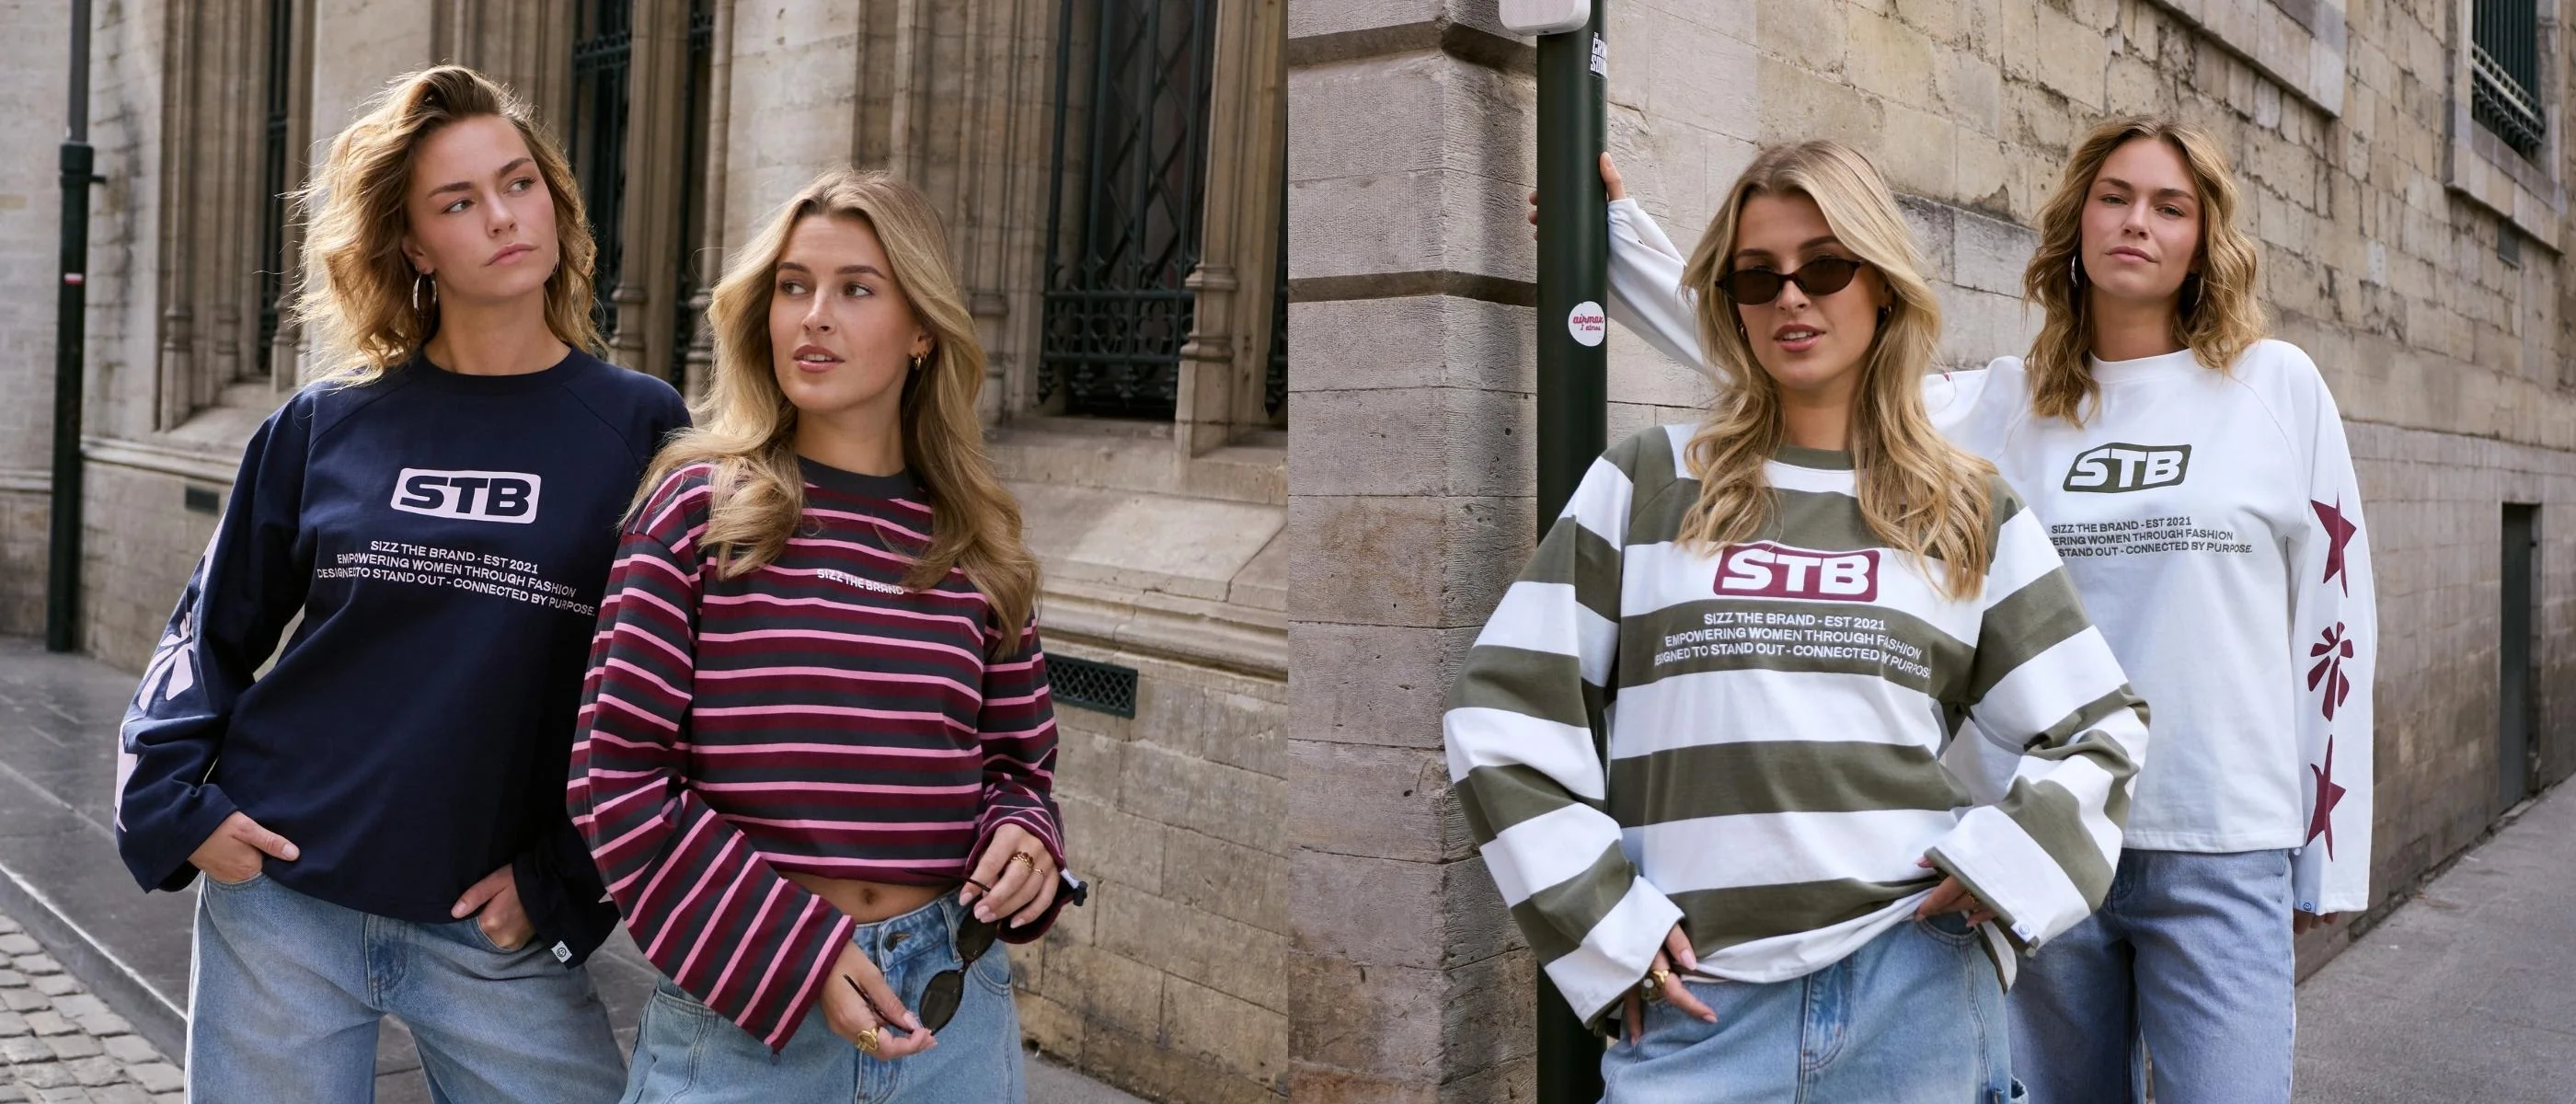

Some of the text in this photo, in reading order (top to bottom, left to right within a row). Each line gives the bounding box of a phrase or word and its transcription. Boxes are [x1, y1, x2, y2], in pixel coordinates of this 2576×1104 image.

[2070, 448, 2183, 489] STB
[400, 475, 532, 517] STB
[2050, 529, 2233, 546] ERING WOMEN THROUGH FASHION
[2052, 524, 2075, 534] SIZZ
[2076, 523, 2098, 533] THE
[2099, 521, 2139, 533] BRAND
[2145, 518, 2165, 528] EST
[2167, 516, 2191, 526] 2021
[371, 541, 398, 553] SIZZ
[401, 544, 426, 557] THE
[430, 547, 475, 561] BRAND
[483, 554, 509, 568] EST
[509, 559, 538, 574] 2021
[2057, 547, 2093, 558] STAND
[2095, 546, 2119, 557] OUT
[2126, 542, 2189, 554] CONNECTED
[2191, 542, 2205, 551] BY
[337, 553, 577, 598] EMPOWERING WOMEN THROUGH FASHION
[817, 568, 904, 595] SIZZ THE BRAND
[1722, 548, 1870, 595] STB
[356, 567, 371, 578] TO
[373, 569, 415, 582] STAND
[418, 574, 445, 586] OUT
[454, 578, 529, 602] CONNECTED
[531, 593, 548, 605] BY
[549, 597, 595, 617] PURPOSE.
[1704, 613, 1734, 625] SIZZ
[1735, 612, 1764, 624] THE
[1766, 613, 1815, 627] BRAND
[1825, 615, 1852, 627] EST
[1853, 617, 1886, 630] 2021
[1665, 627, 1923, 661] EMPOWERING WOMEN THROUGH FASHION
[1692, 646, 1708, 658] TO
[1710, 643, 1754, 655] STAND
[1755, 643, 1785, 656] OUT
[1793, 645, 1880, 661] CONNECTED
